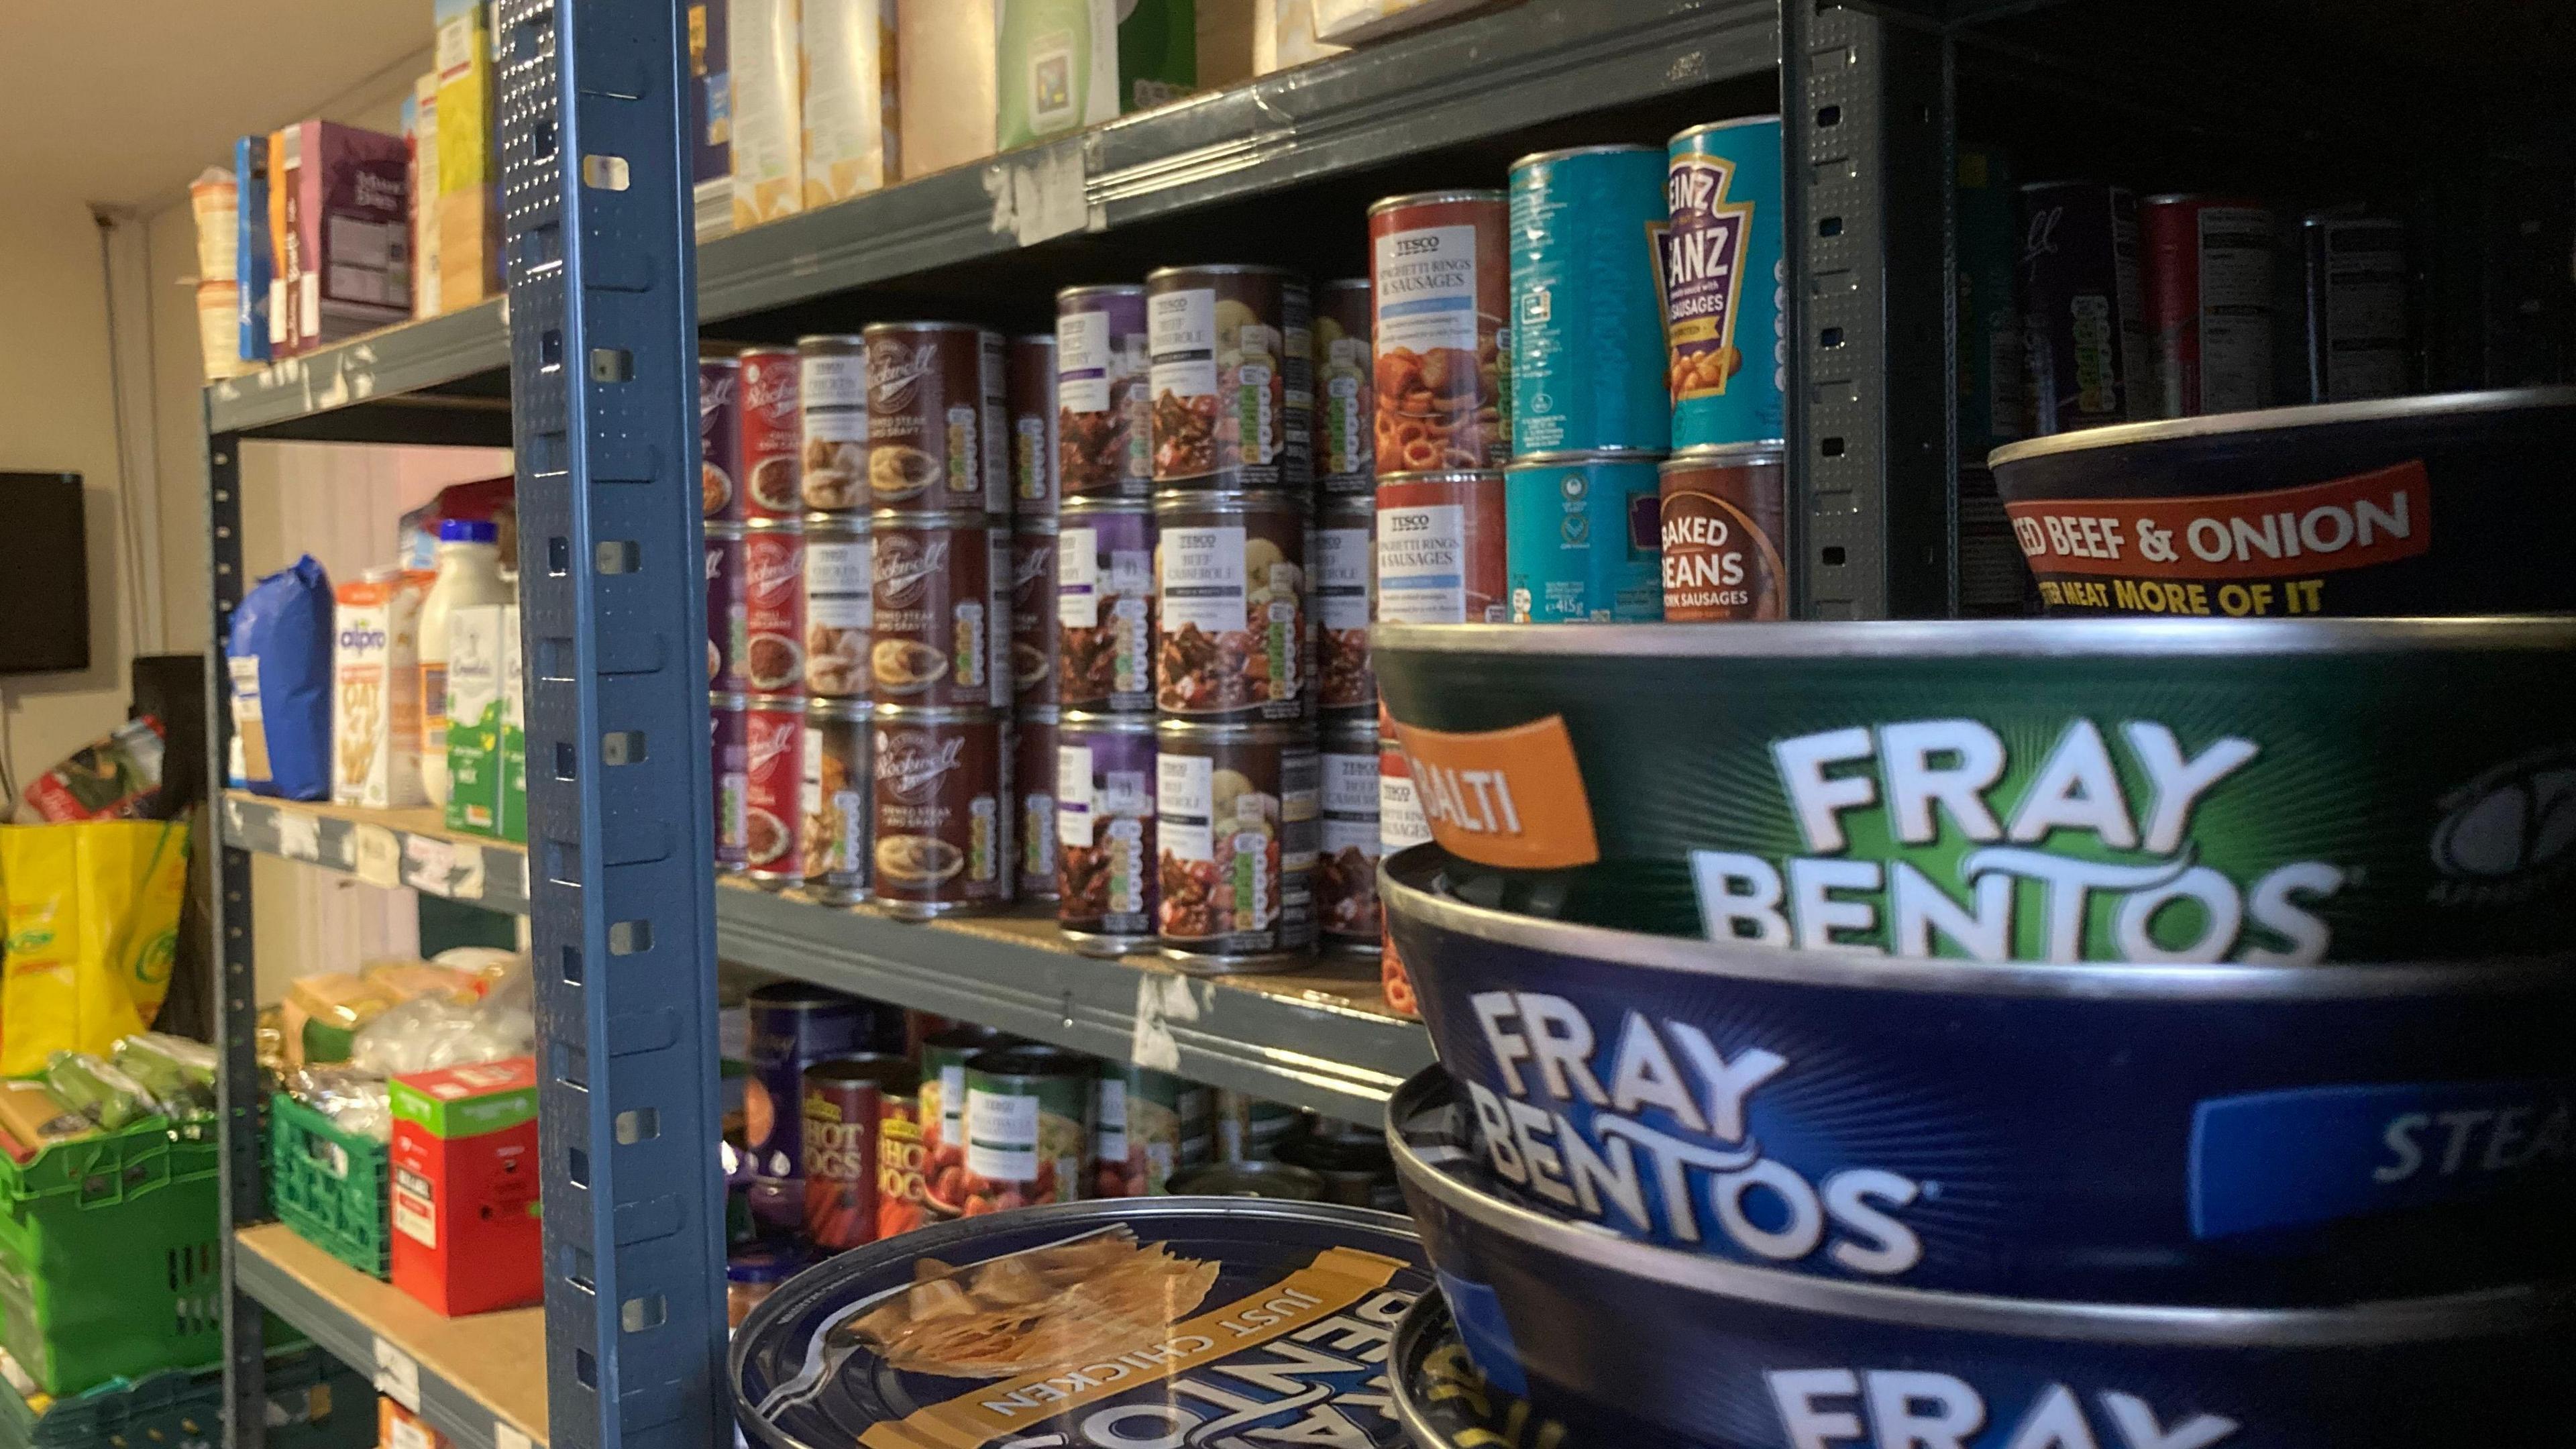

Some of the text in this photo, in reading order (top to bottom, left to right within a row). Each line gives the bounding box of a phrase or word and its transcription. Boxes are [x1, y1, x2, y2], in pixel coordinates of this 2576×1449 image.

[1670, 172, 1714, 215] EINZ
[1397, 235, 1440, 254] TESCO
[1669, 227, 1729, 288] ANZ
[1391, 273, 1465, 294] SAUSAGES
[1432, 258, 1471, 272] RINGS
[1391, 515, 1430, 528] TESCO
[1661, 516, 1729, 553] BAKED
[2012, 490, 2411, 563] CED BEEF & ONION
[1387, 551, 1454, 568] SAUSAGES
[1681, 590, 1749, 607] SAUSAGES
[2061, 581, 2109, 608] MEAT
[2113, 579, 2211, 616] MORE
[2218, 583, 2273, 617] OF
[2285, 579, 2325, 614] IT
[341, 619, 385, 656] alpro
[1770, 718, 2261, 855] FRAY
[1689, 842, 2345, 965] BENTOS
[1468, 989, 1790, 1143] FRAY
[804, 1146, 863, 1180] OGS
[881, 1139, 927, 1172] HO
[1466, 1079, 1924, 1276] BENTOS
[1219, 1287, 1324, 1339] JUST
[980, 1334, 1215, 1417] CHICKEN
